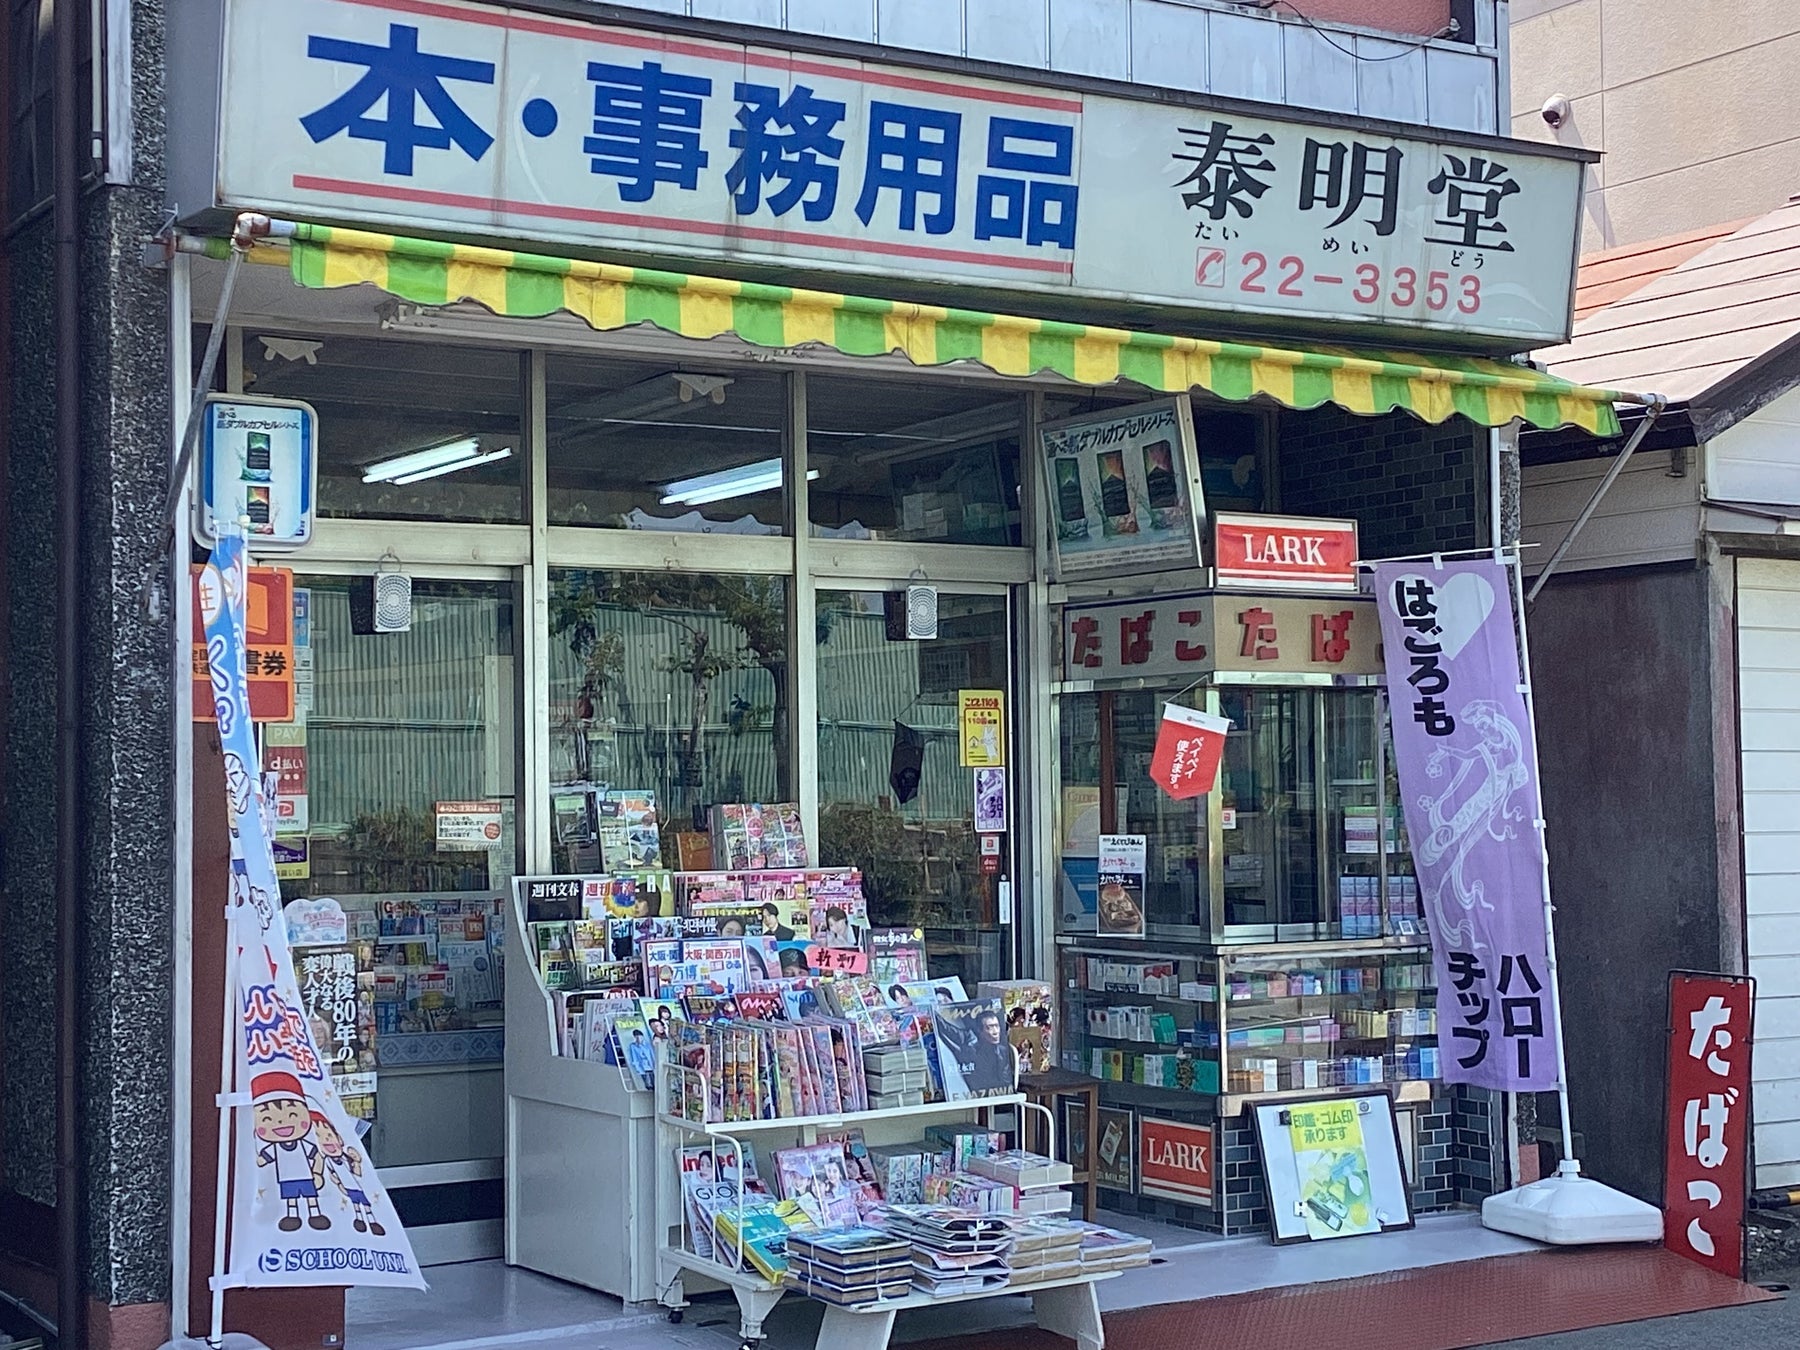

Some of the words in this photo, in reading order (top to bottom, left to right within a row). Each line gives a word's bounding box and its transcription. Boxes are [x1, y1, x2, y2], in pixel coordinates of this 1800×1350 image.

[299, 23, 1080, 250] 本・事務用品
[1171, 120, 1521, 252] 泰明堂
[1194, 221, 1239, 240] たい
[1322, 237, 1369, 255] めい
[1450, 250, 1485, 269] どう
[1242, 533, 1327, 566] LARK
[1071, 609, 1207, 668] たばこ
[1238, 606, 1385, 663] たば
[1395, 579, 1456, 737] はごろも
[274, 728, 299, 739] PAY
[1185, 736, 1205, 779] ペイペイ
[270, 756, 304, 770] d払い
[1169, 739, 1190, 790] 使えます。
[531, 881, 580, 898] 週刊文春
[672, 964, 698, 981] 万博
[684, 947, 741, 961] 大阪・関西万博
[332, 953, 358, 1062] 戦後80年の
[1447, 951, 1491, 1069] チップ
[1495, 953, 1544, 1078] ハロー
[1292, 1109, 1354, 1129] 印鑑・ゴム印
[1304, 1126, 1348, 1144] 承ります
[1683, 995, 1740, 1257] たばこ
[1147, 1137, 1208, 1174] LARK
